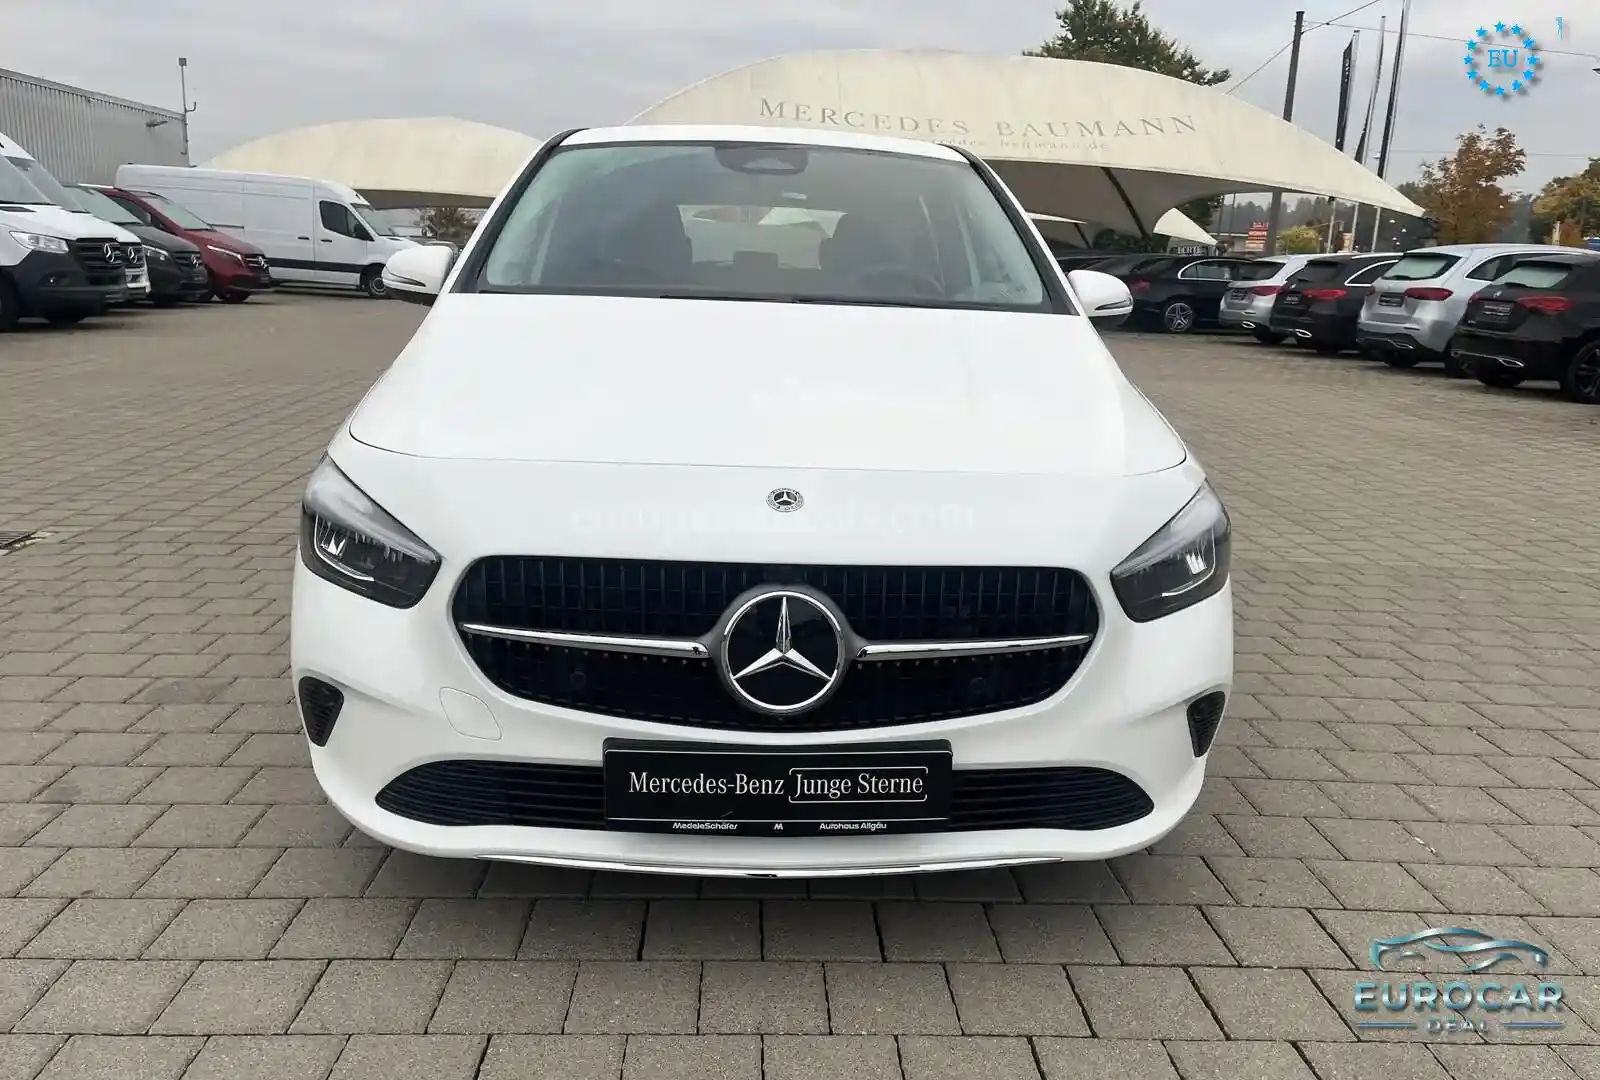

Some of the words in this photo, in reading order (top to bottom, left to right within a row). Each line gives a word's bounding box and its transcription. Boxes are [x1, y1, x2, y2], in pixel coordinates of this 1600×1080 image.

[759, 98, 970, 135] MERCEDES
[996, 115, 1197, 138] BAUMANN
[628, 771, 785, 796] Mercedes-Benz
[795, 773, 853, 799] Junge
[857, 772, 924, 795] Sterne
[819, 822, 860, 830] Autohaus
[860, 821, 887, 832] Allgäu
